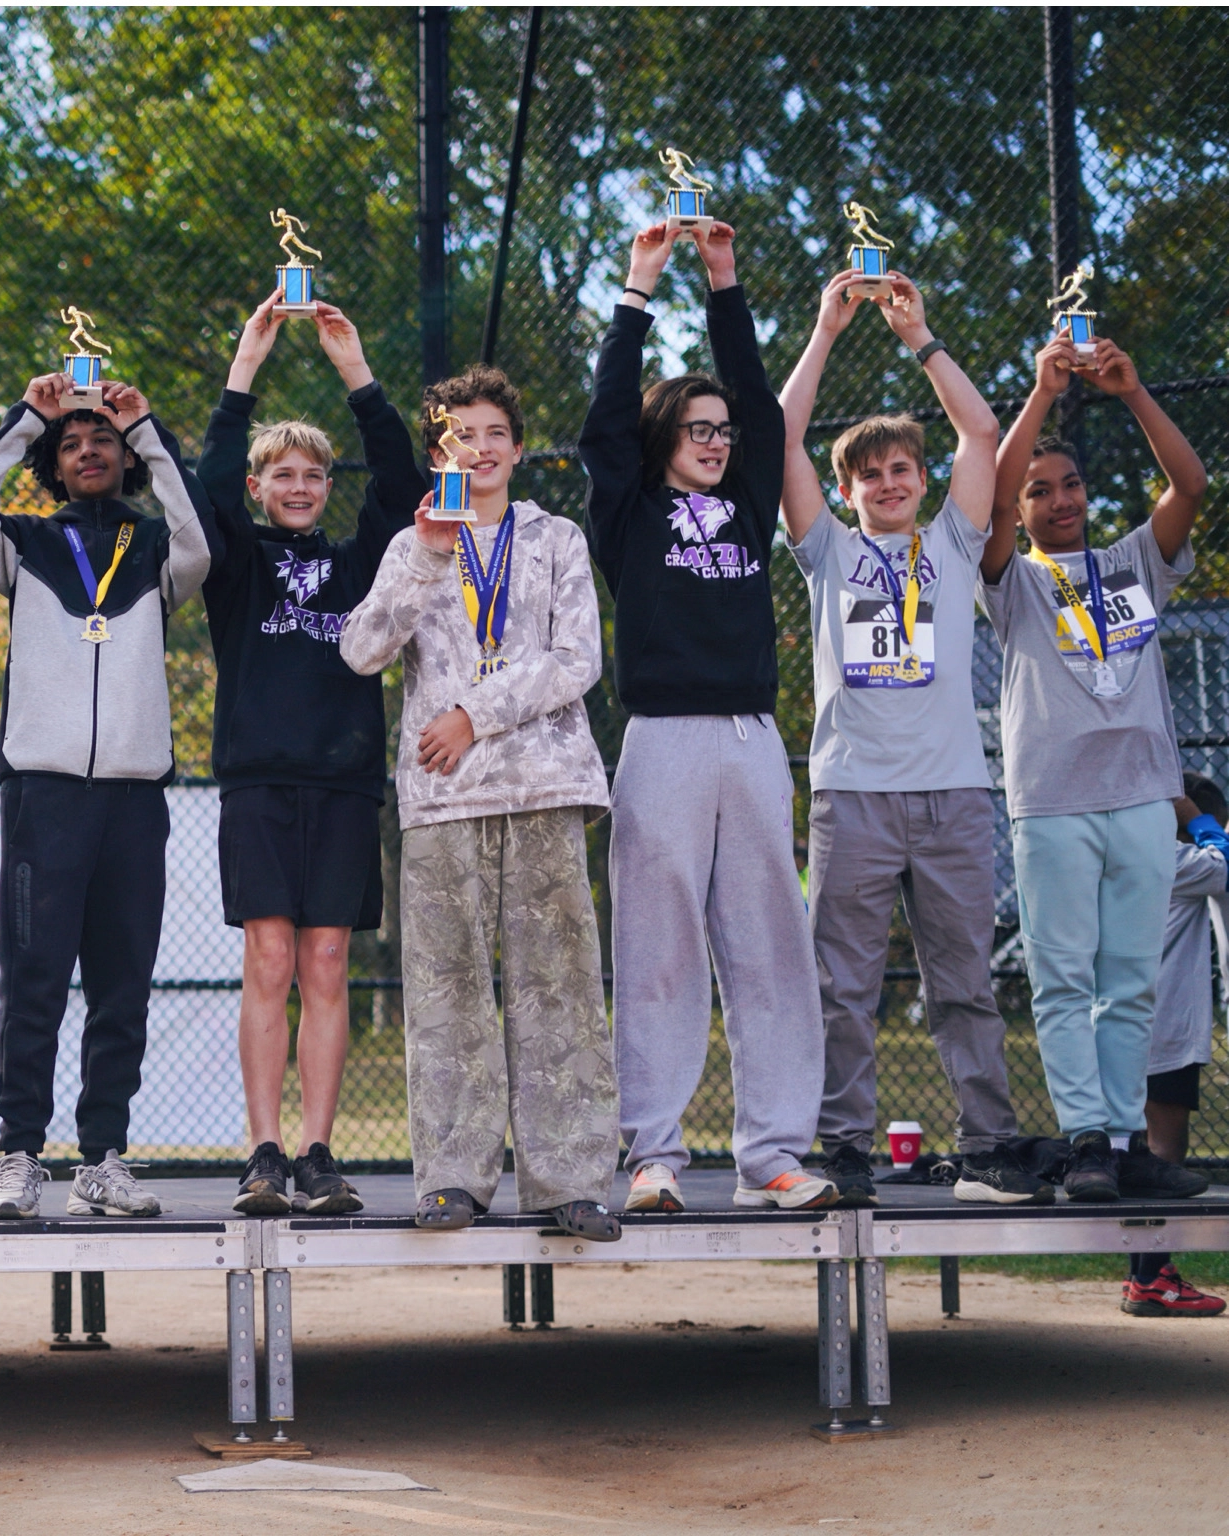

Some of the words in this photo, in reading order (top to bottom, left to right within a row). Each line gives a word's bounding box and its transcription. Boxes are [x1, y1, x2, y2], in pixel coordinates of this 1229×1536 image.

[847, 553, 938, 598] LATN
[1057, 578, 1081, 607] MSXC
[872, 626, 900, 658] 81
[1107, 626, 1142, 644] MSXC
[846, 668, 868, 676] B.A.A.
[869, 665, 900, 677] MSX
